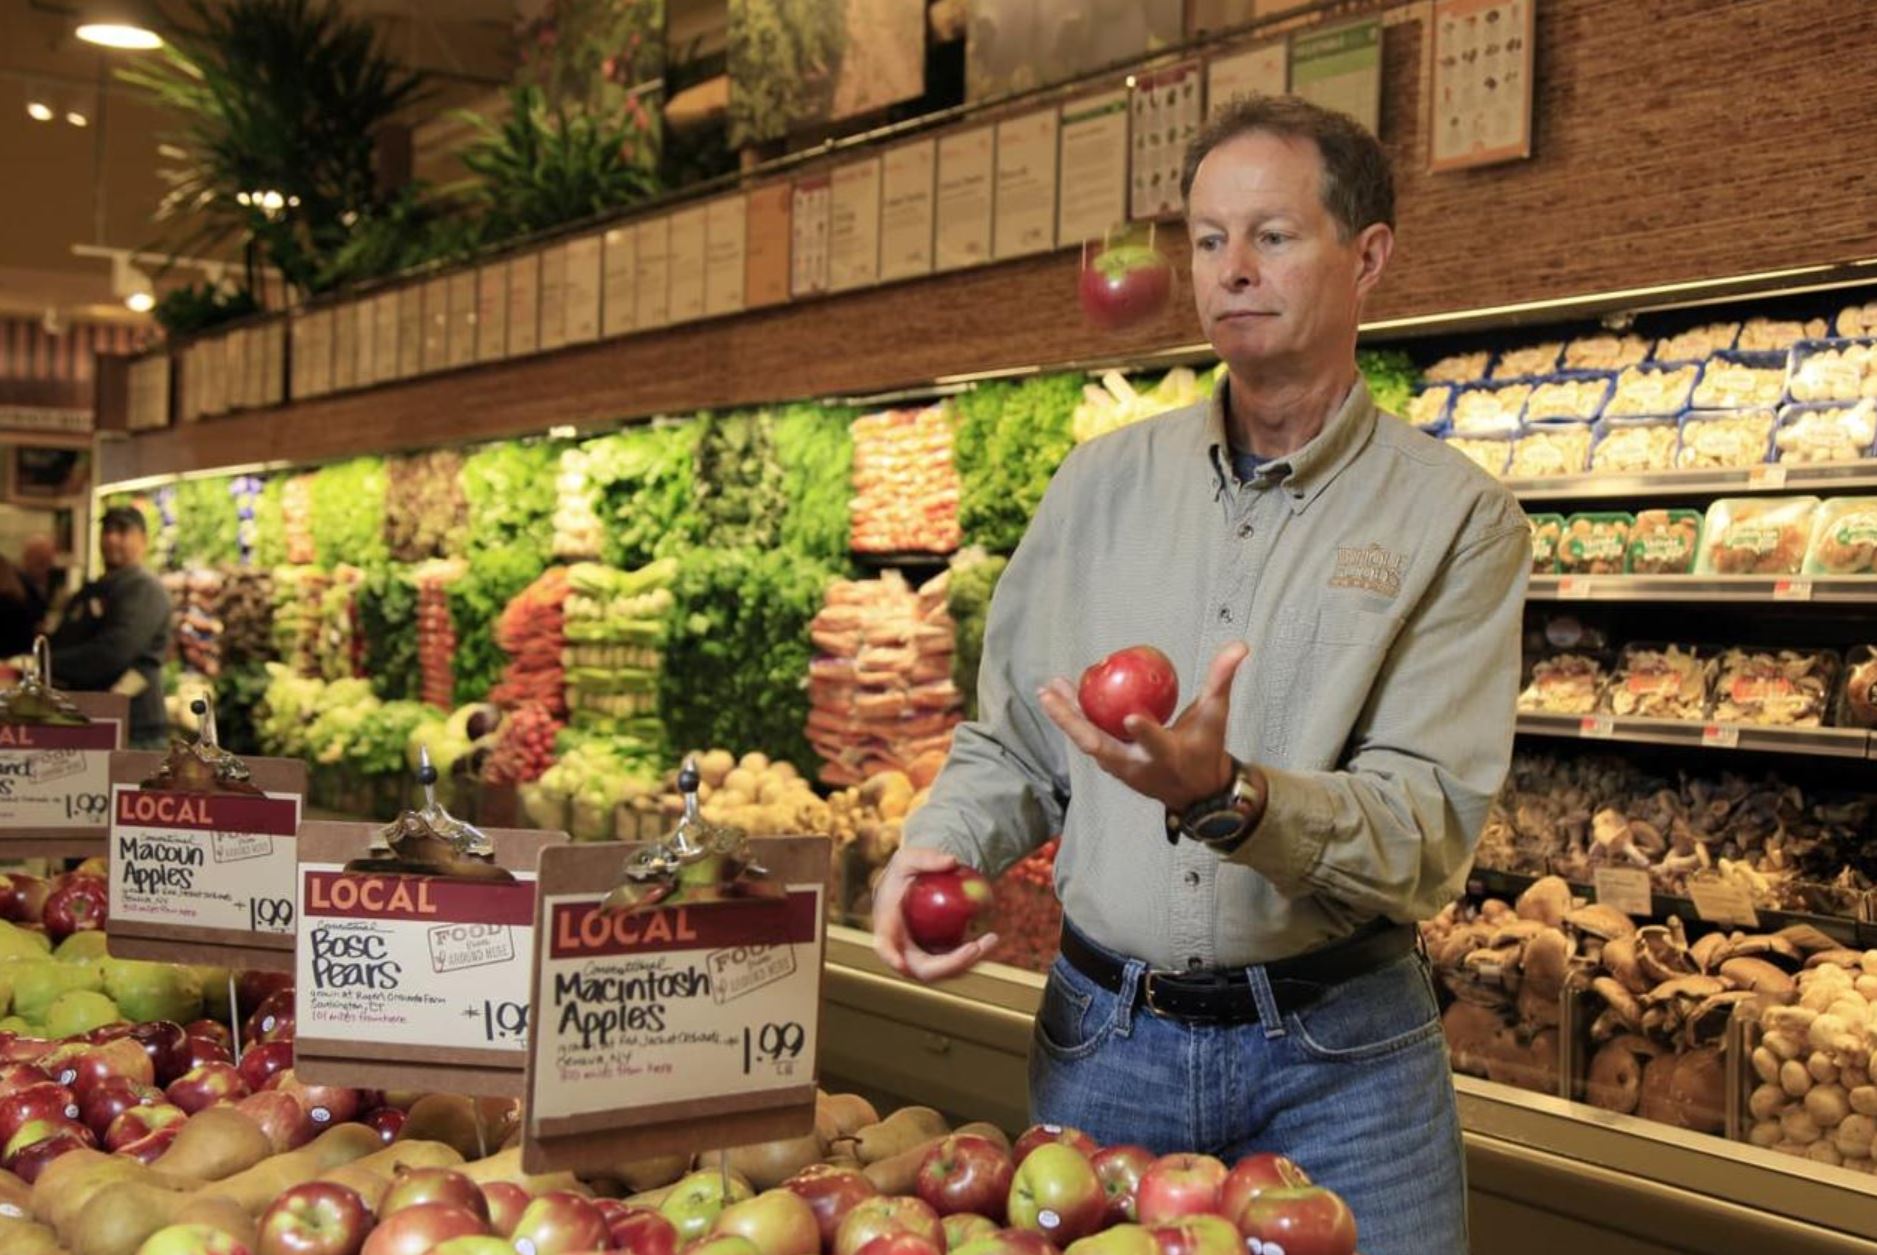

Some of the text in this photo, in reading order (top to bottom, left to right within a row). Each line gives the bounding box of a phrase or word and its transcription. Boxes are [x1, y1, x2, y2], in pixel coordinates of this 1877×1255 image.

[66, 793, 108, 818] 1.99
[121, 794, 213, 824] LOCAL
[120, 836, 204, 867] Macoun
[123, 860, 194, 895] Apples
[311, 877, 437, 913] LOCAL
[250, 897, 293, 931] 1.99
[558, 908, 697, 949] LOCAL
[310, 928, 388, 960] Bosc
[311, 955, 402, 990] Pears
[554, 966, 710, 1006] Macintosh
[558, 1001, 665, 1050] Apples
[743, 1022, 805, 1075] 1.99
